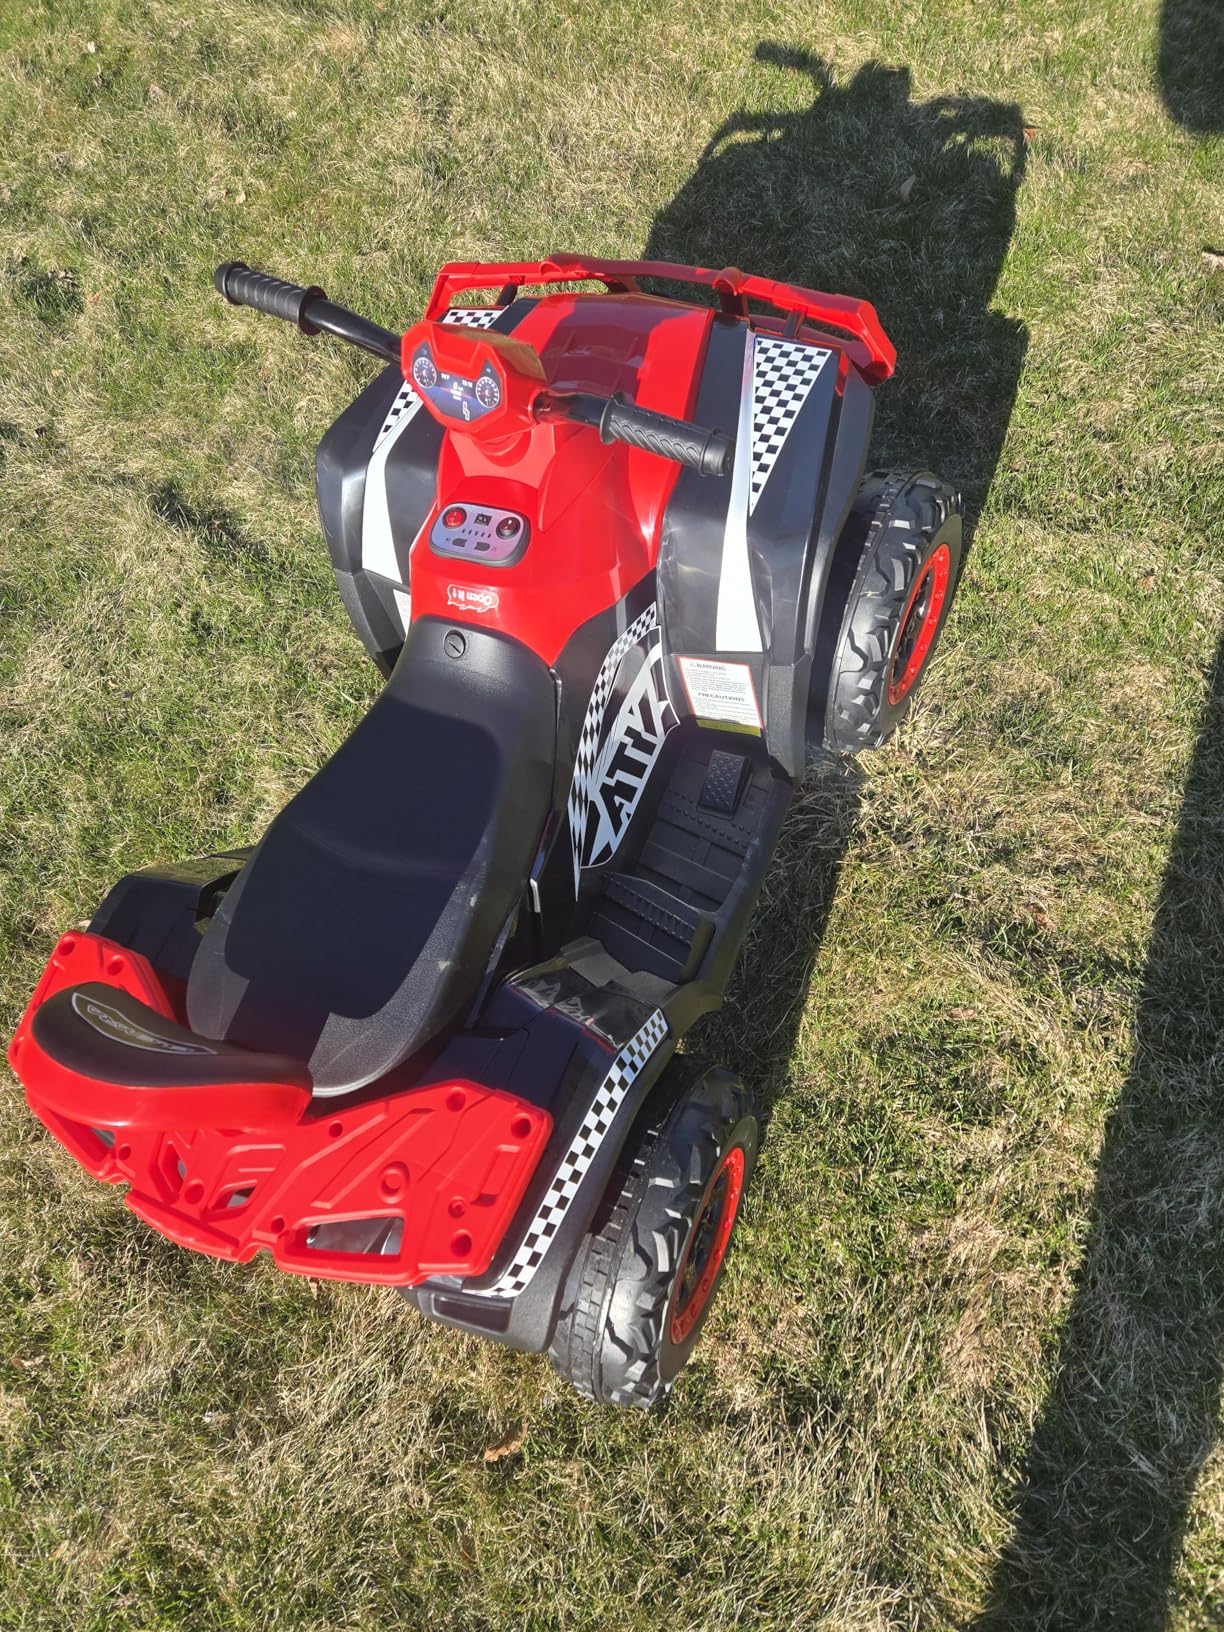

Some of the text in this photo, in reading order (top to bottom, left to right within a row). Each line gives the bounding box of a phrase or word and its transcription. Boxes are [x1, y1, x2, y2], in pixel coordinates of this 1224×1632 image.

[466, 592, 492, 605] Open
[697, 663, 726, 671] WARNING
[697, 692, 745, 702] PRECAUTIONS
